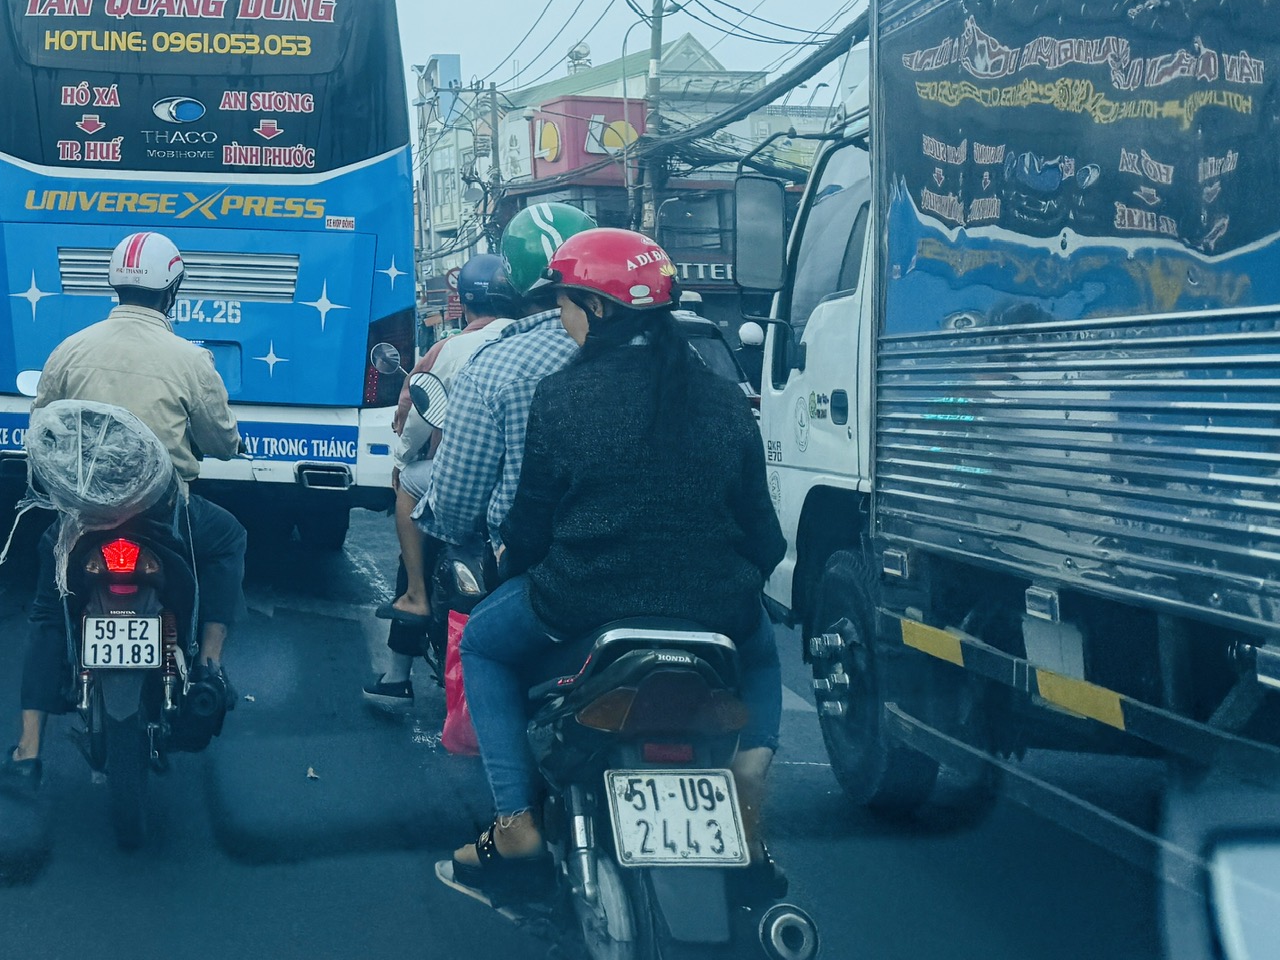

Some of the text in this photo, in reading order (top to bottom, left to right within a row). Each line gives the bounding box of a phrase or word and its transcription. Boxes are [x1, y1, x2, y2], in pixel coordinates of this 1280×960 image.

[45, 30, 312, 56] HOTLINE: 0961.053.053
[61, 81, 121, 108] HỒ XÁ
[219, 91, 315, 113] AN SƯƠNG
[141, 130, 218, 144] THACO
[85, 136, 125, 162] HUẾ
[146, 149, 215, 159] MOBIHOME
[222, 143, 315, 169] BÌNH PHƯỚC
[262, 437, 308, 457] TRONG
[311, 437, 357, 459] THÁNG
[95, 620, 149, 640] 59-E2
[91, 643, 155, 665] 131.83
[658, 653, 692, 663] HONDA
[637, 819, 725, 854] 2443
